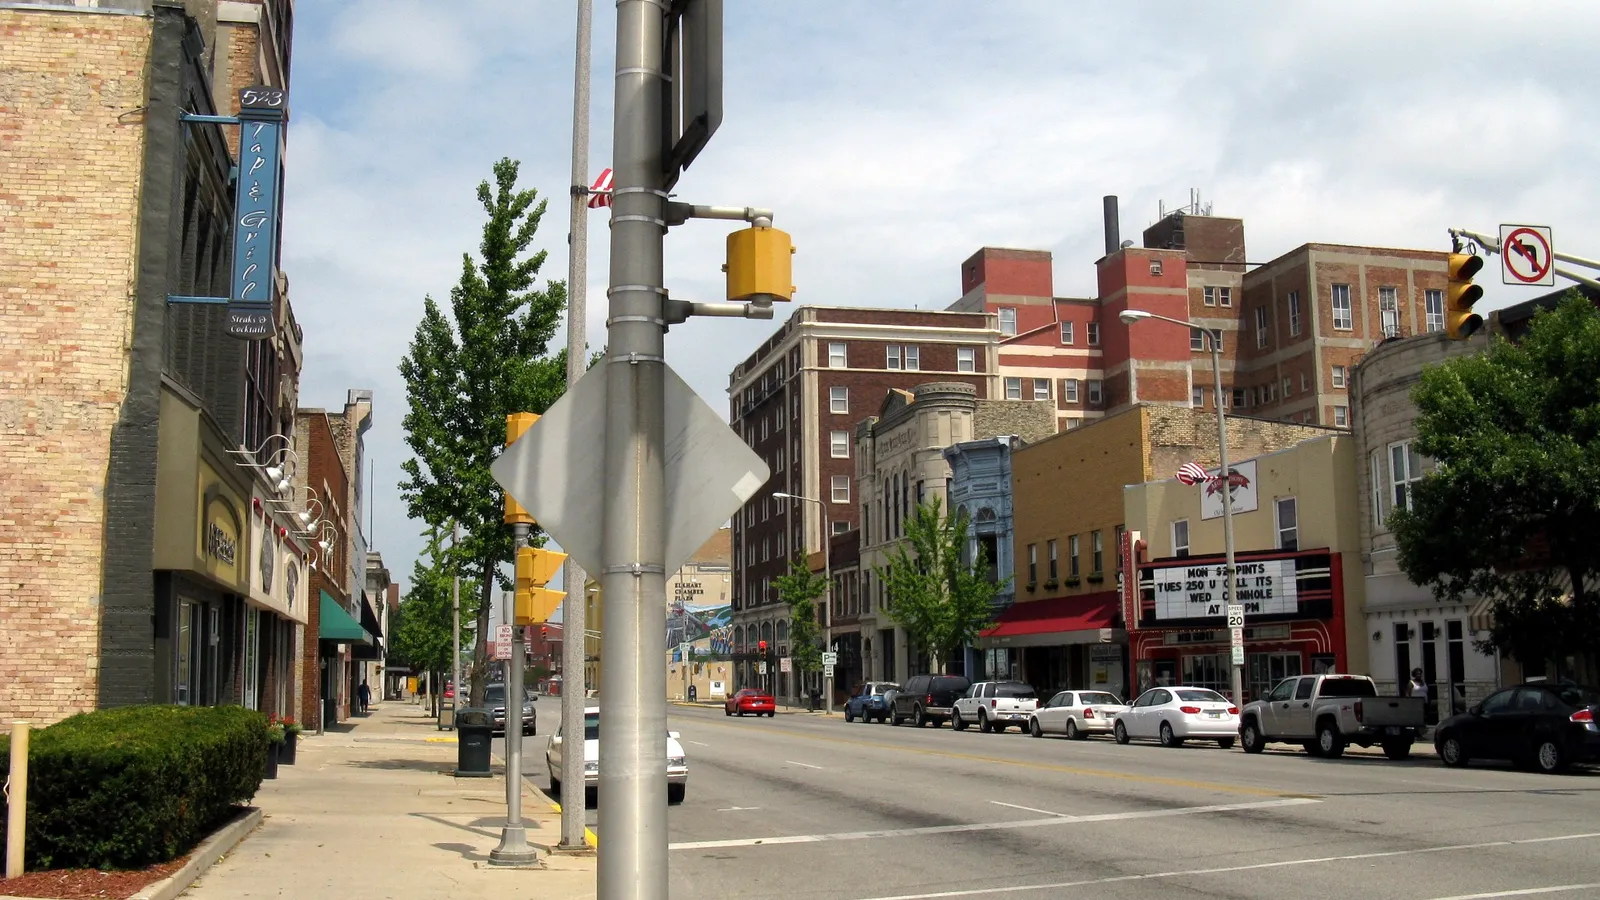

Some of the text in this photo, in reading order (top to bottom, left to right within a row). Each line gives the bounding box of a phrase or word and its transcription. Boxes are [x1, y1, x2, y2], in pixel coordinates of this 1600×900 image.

[241, 90, 282, 106] 523
[249, 121, 273, 175] Tap
[241, 210, 267, 299] Grill
[231, 315, 256, 323] Steaks
[230, 324, 266, 333] Cocktails
[1187, 568, 1208, 578] MON
[1236, 564, 1265, 575] PINTS
[1157, 576, 1272, 593] TUES 250 U CLL ITS
[1190, 589, 1272, 603] WED CRNHOLE
[1208, 602, 1259, 615] AT PM
[1230, 617, 1243, 625] 20
